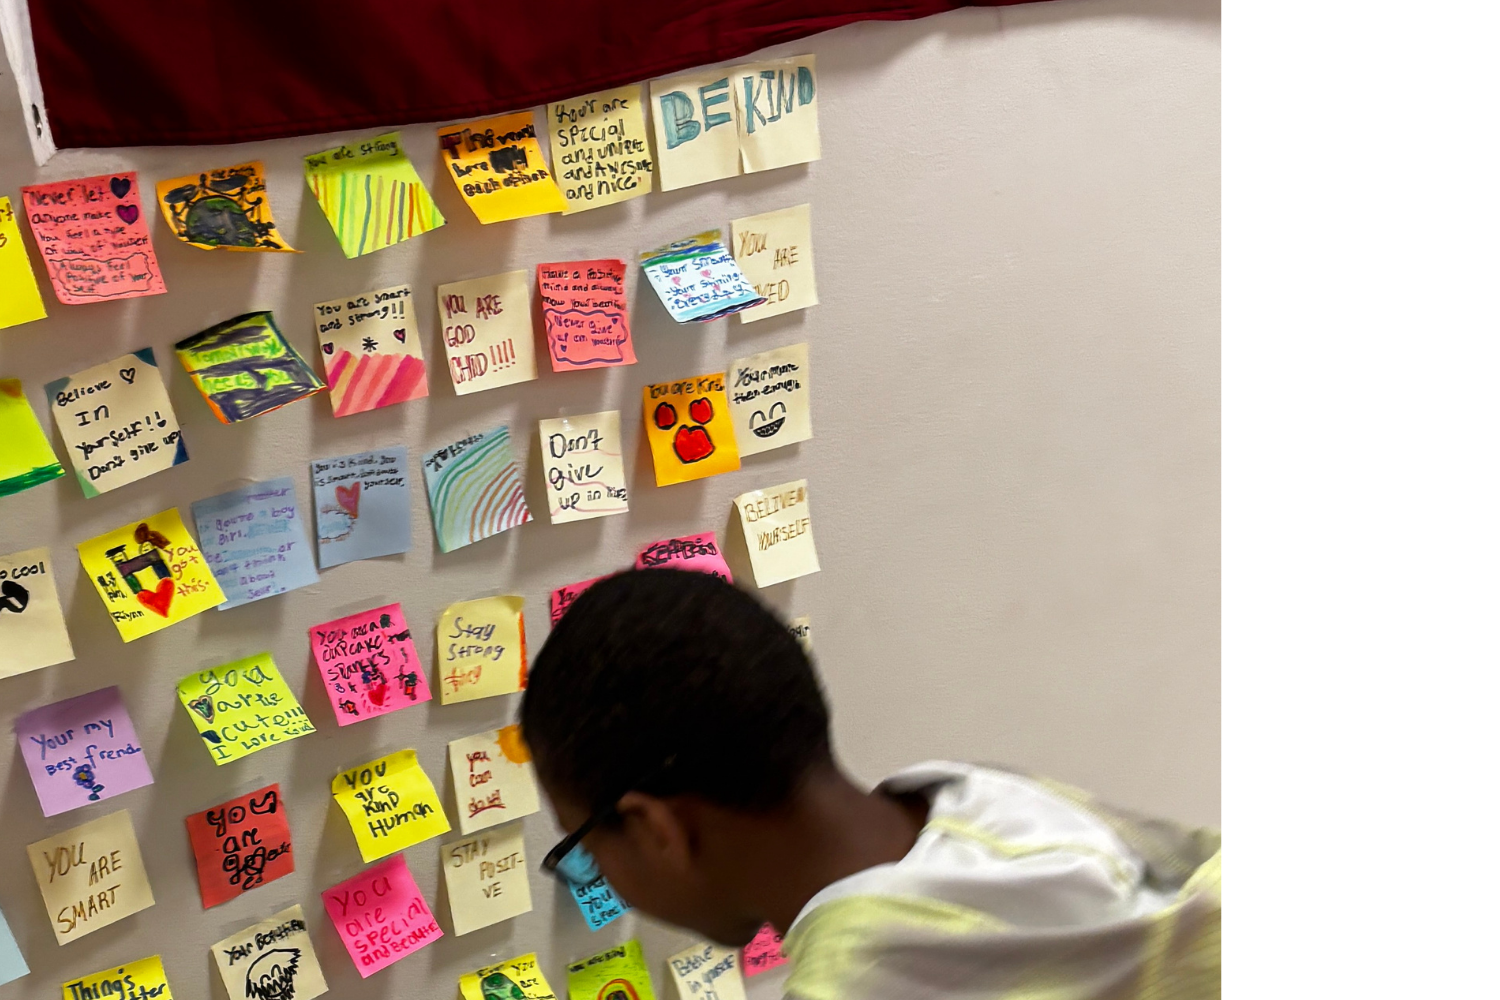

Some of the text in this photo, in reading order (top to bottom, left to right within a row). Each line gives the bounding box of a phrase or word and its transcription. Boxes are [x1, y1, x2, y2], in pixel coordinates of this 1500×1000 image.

[660, 66, 815, 150] BE KIND
[739, 231, 799, 270] YOU ARE
[443, 294, 504, 320] YOU ARE
[445, 324, 476, 348] GOD
[11, 561, 47, 581] cool
[449, 616, 497, 641] Stay
[30, 718, 115, 760] Your my
[211, 744, 233, 760] I
[344, 761, 387, 790] YOU
[45, 841, 88, 884] YOU
[451, 838, 490, 868] STAY
[88, 850, 123, 887] ARE
[482, 882, 503, 900] VE
[57, 884, 122, 935] SMART
[345, 907, 387, 938] are
